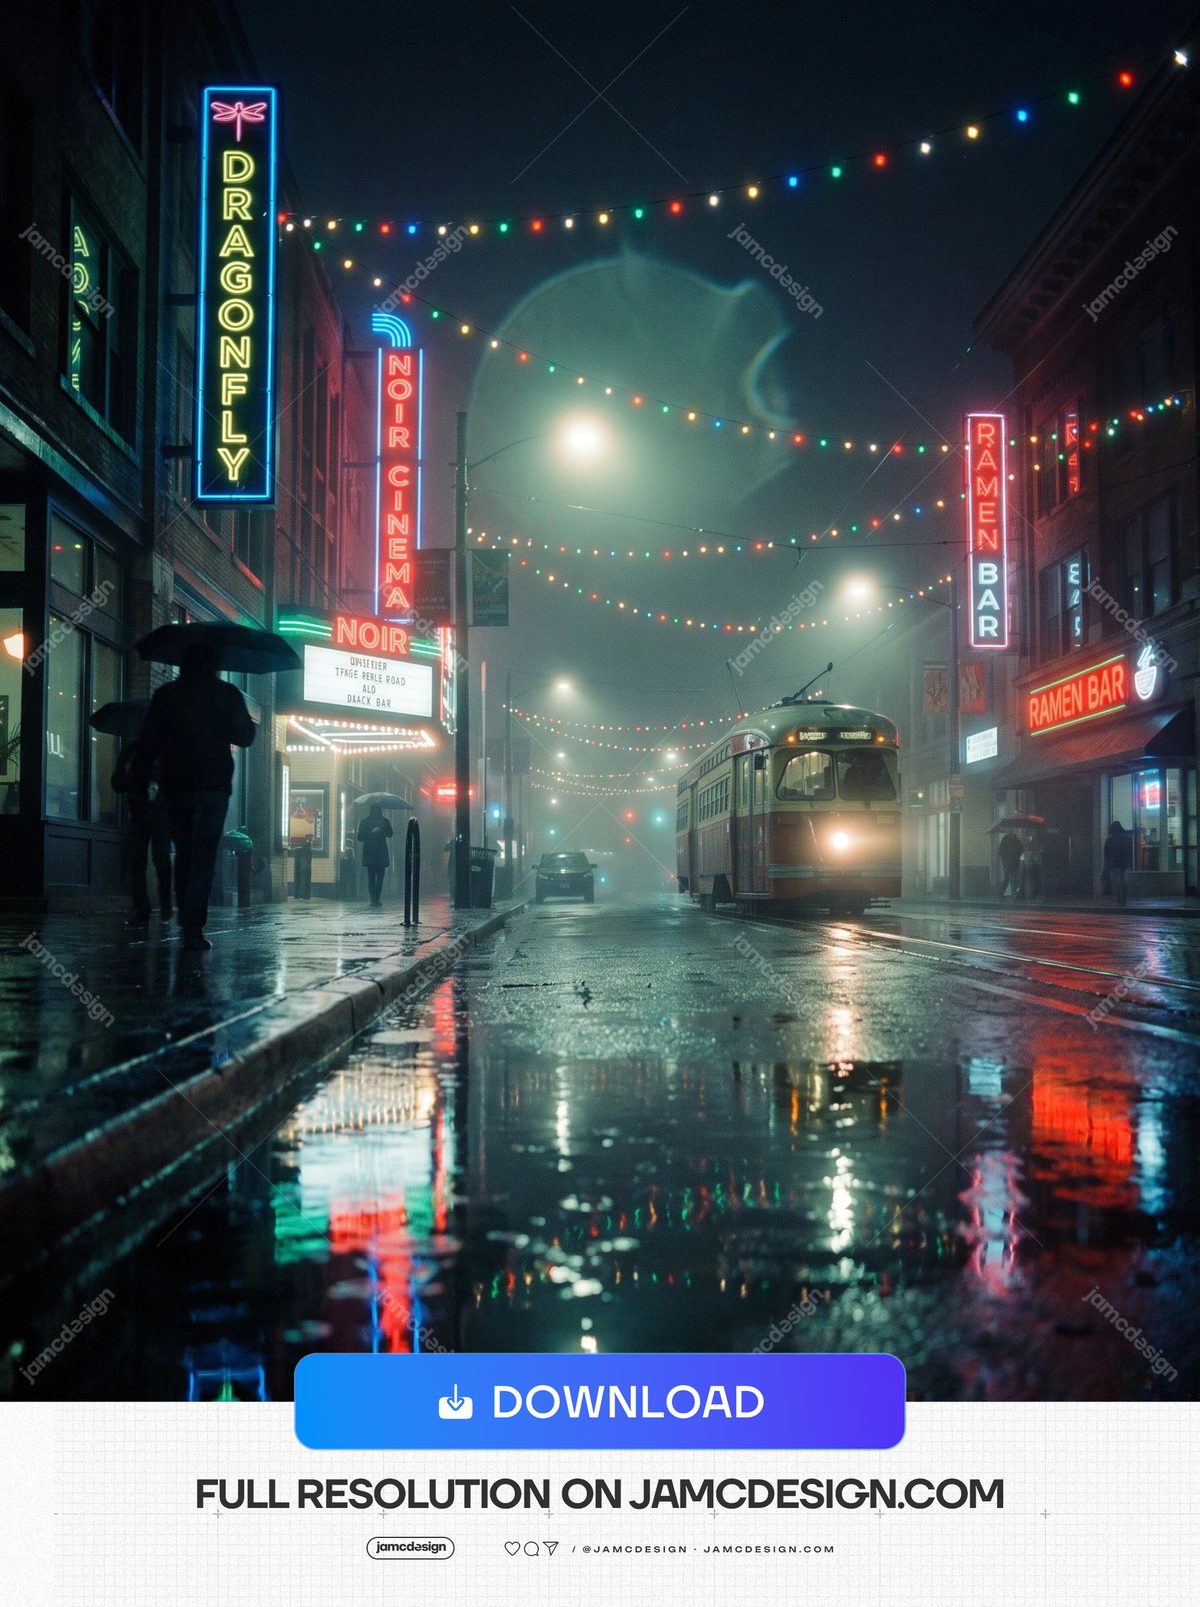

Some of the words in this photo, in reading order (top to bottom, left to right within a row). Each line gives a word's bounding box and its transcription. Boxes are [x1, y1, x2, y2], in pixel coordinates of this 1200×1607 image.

[217, 150, 255, 481] DRAGONFLY
[387, 355, 412, 448] NOIR
[976, 423, 998, 550] RAMEN
[385, 466, 410, 608] CINEMA
[337, 617, 407, 654] NOIR
[977, 563, 1000, 637] BAR
[1029, 680, 1083, 728] RAMEN
[1087, 665, 1125, 710] BAR
